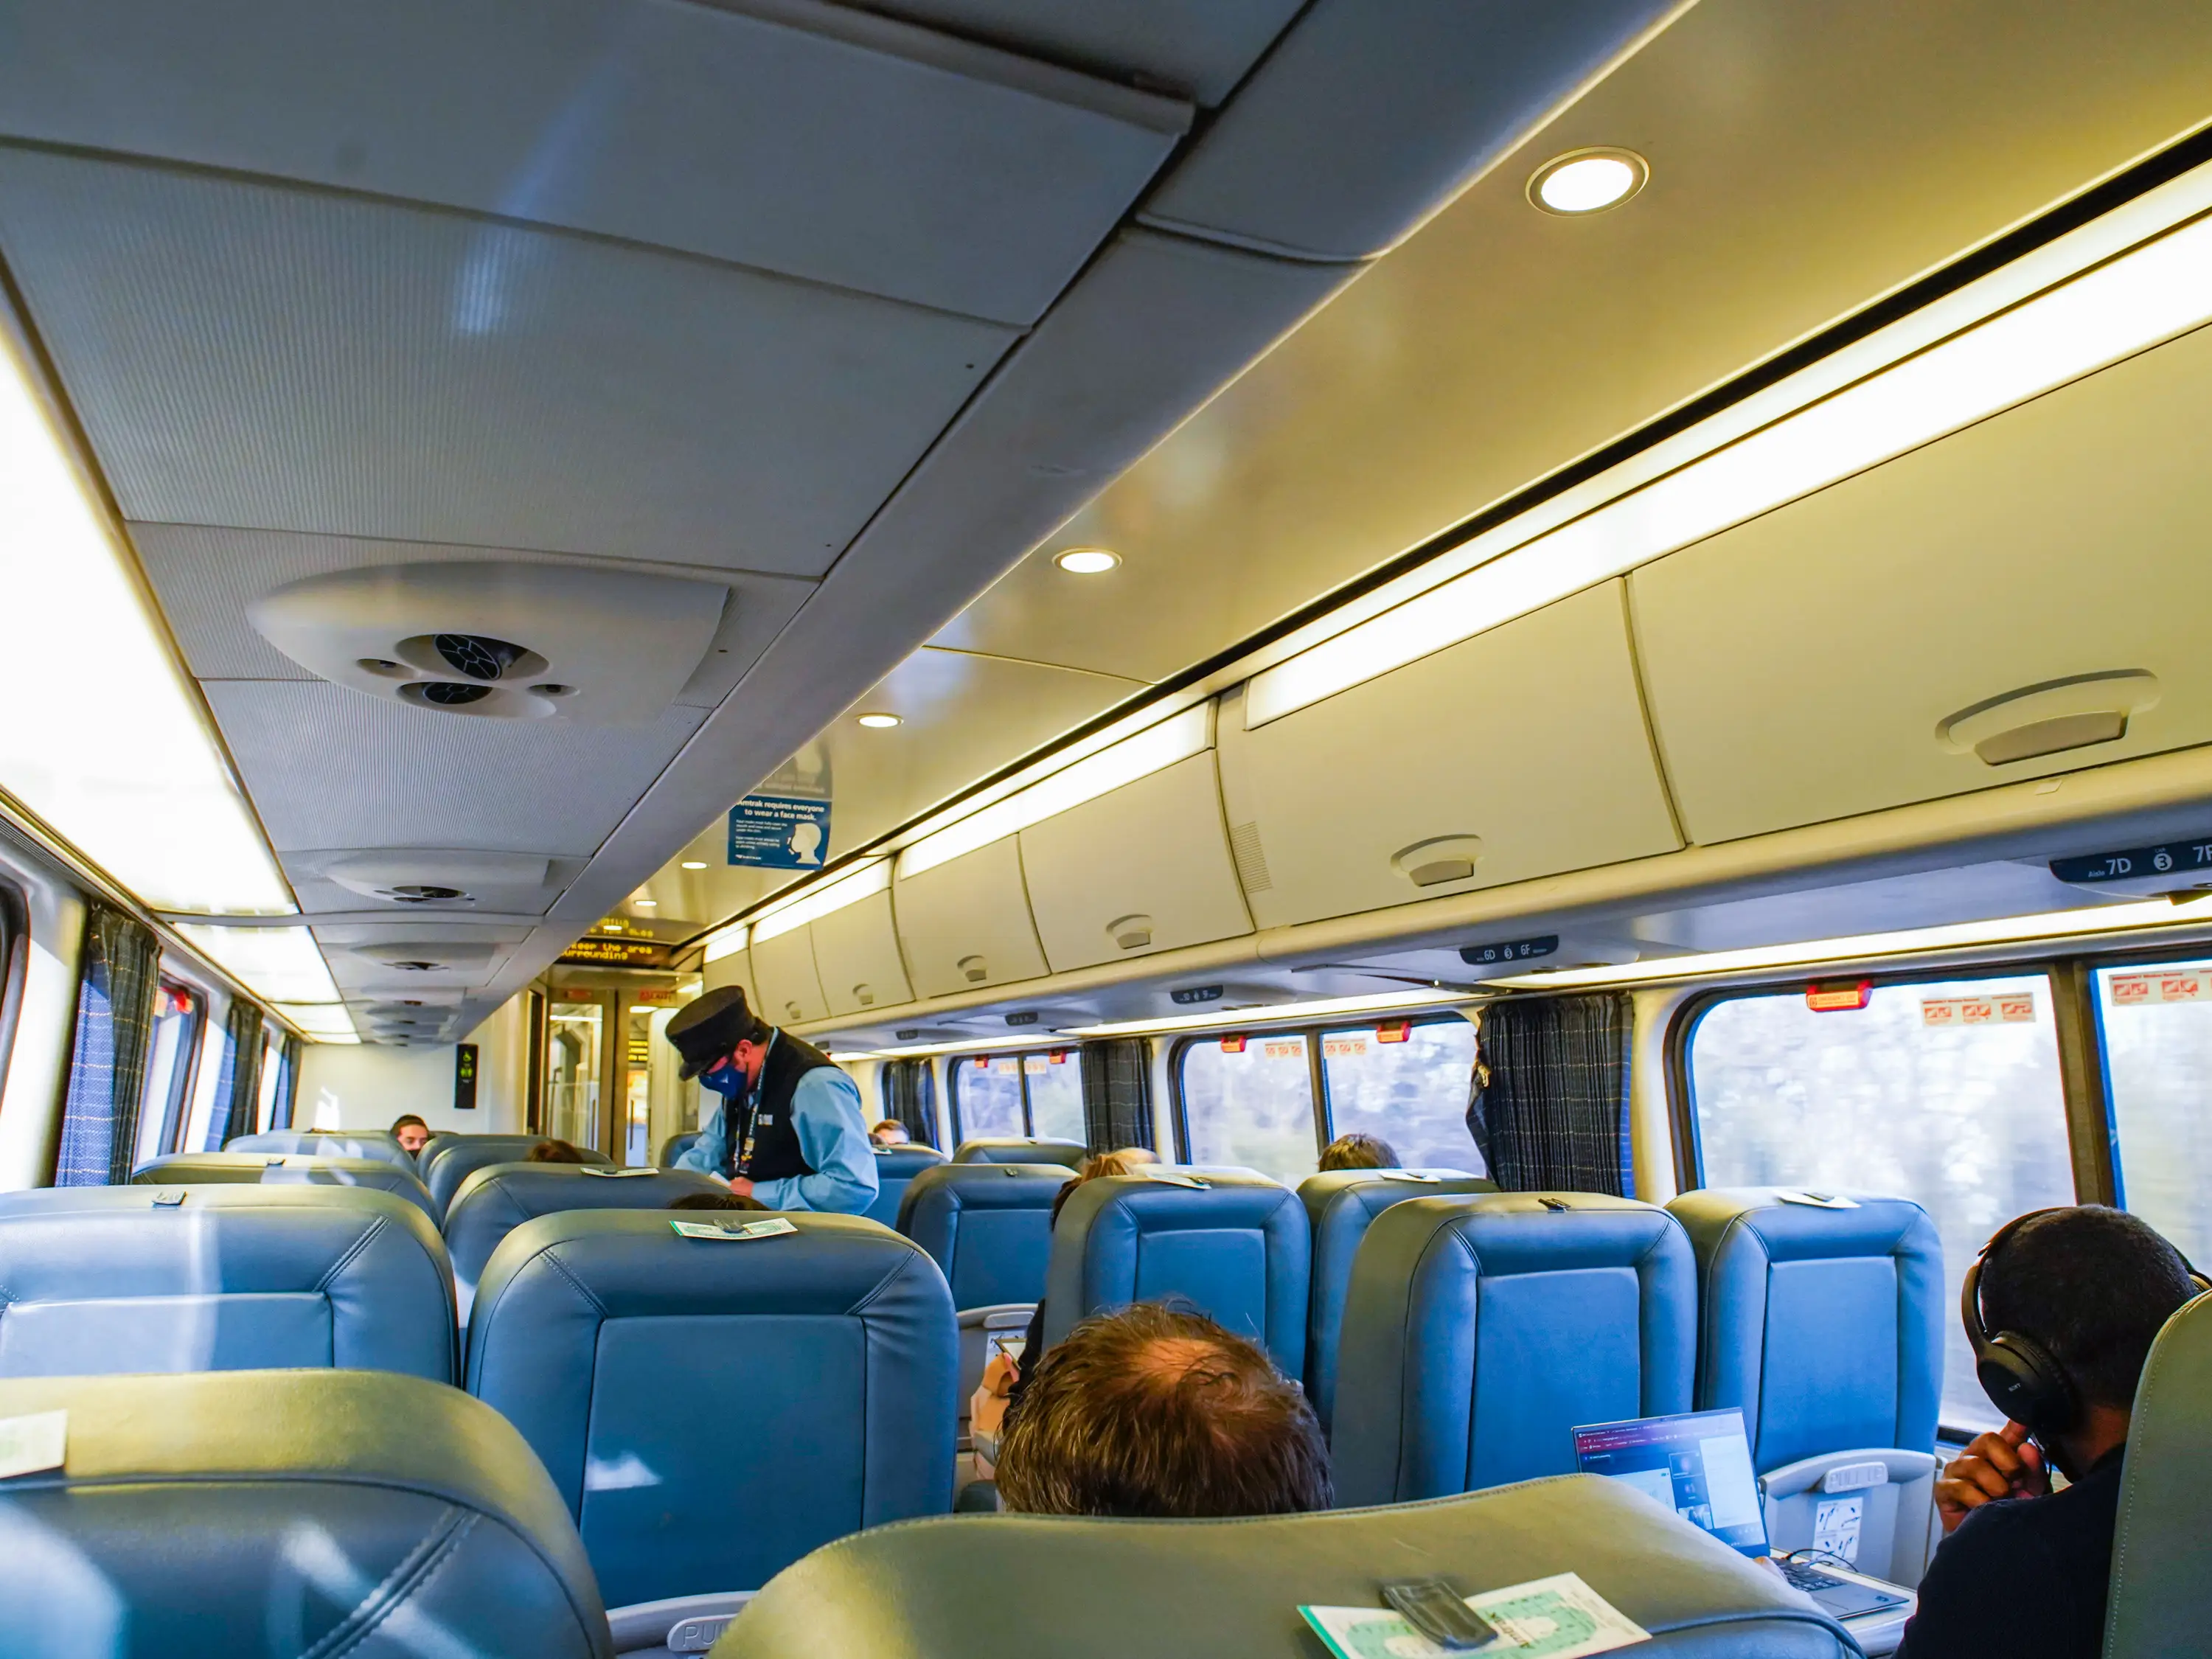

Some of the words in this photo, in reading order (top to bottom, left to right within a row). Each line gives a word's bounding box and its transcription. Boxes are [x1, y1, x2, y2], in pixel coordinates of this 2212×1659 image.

[764, 801, 792, 810] requires
[793, 804, 824, 813] everyone
[780, 810, 795, 818] face
[796, 813, 817, 821] mask.
[2105, 858, 2132, 875] 7D
[602, 942, 622, 952] the
[627, 945, 653, 954] area
[1484, 949, 1495, 960] 6D
[1520, 944, 1531, 956] 6F
[562, 949, 628, 961] urrounding
[1830, 1470, 1863, 1487] PULL
